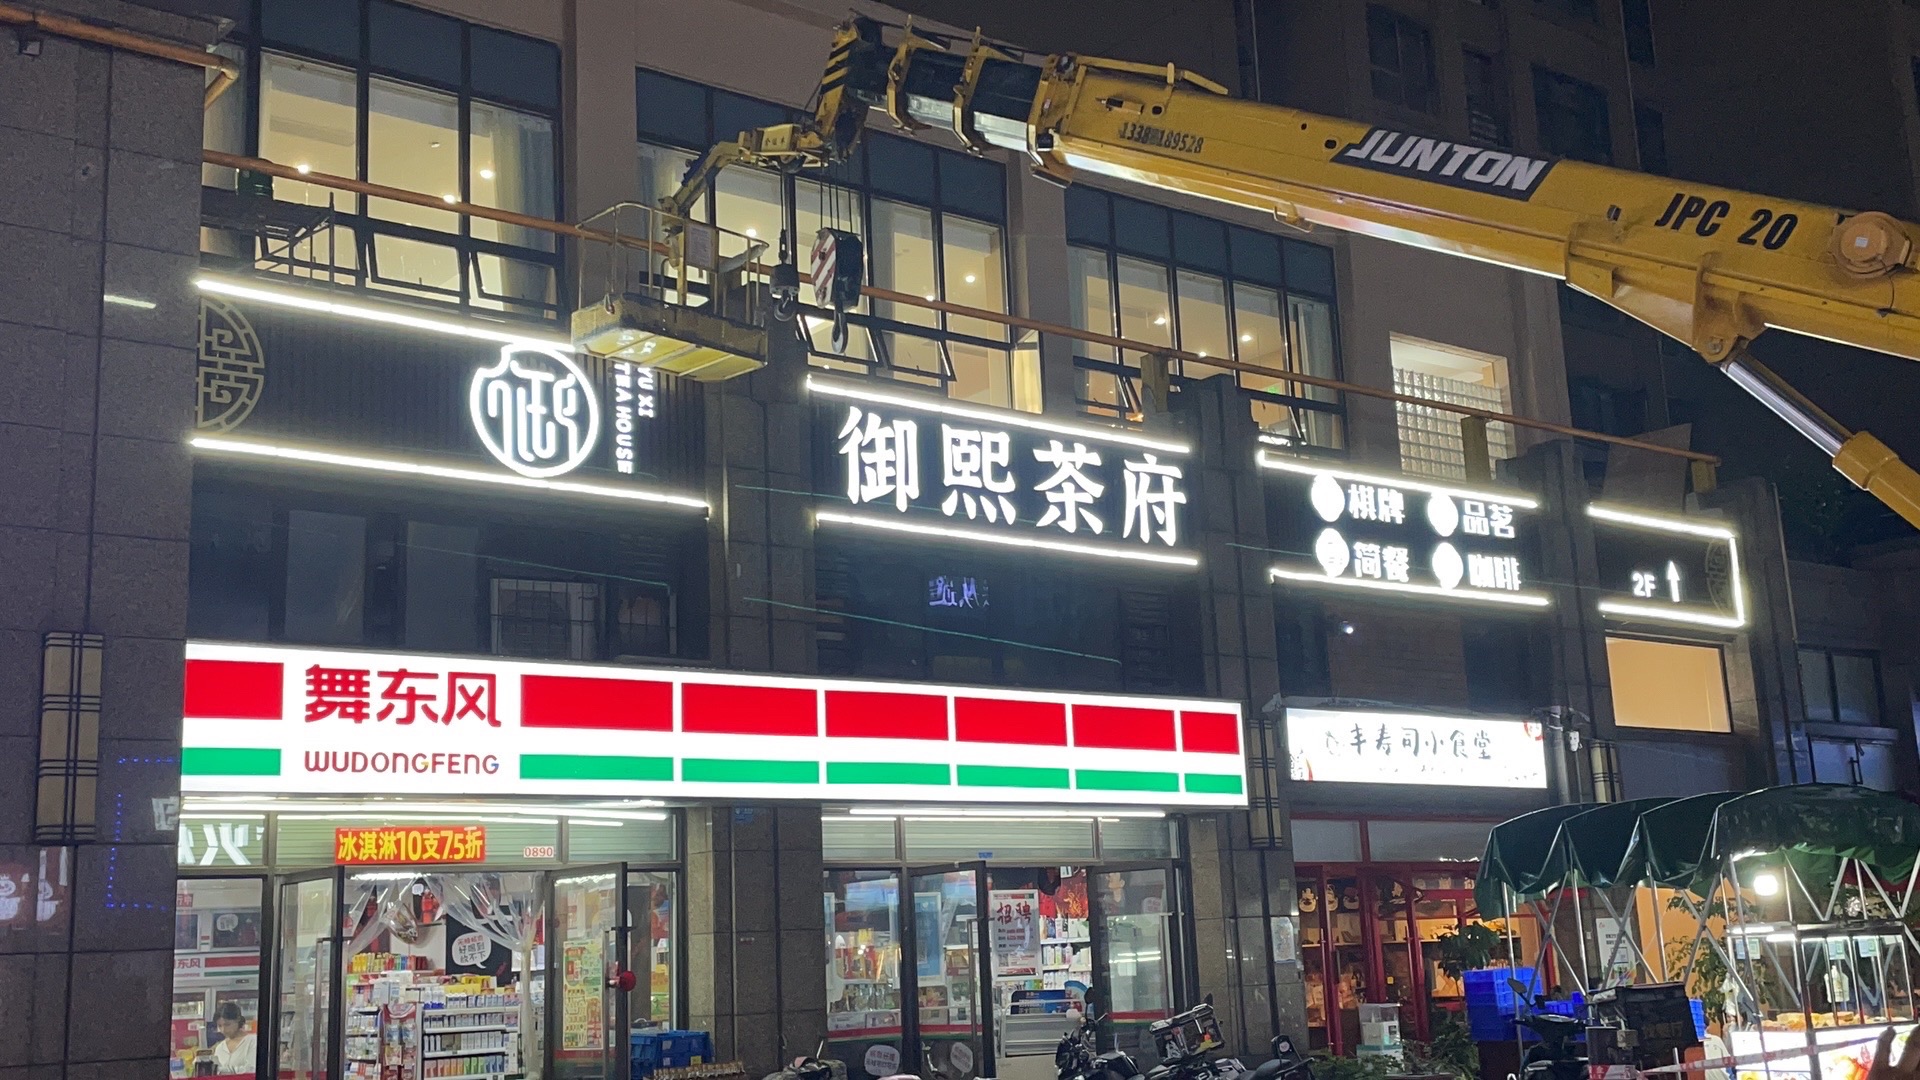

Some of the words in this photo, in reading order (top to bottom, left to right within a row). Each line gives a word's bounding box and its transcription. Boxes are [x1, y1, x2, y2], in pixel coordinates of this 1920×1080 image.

[1118, 122, 1204, 153] 1338189528
[1344, 129, 1548, 191] JUNTON
[1654, 193, 1730, 237] JPC
[1737, 208, 1798, 250] 20
[614, 362, 632, 403] TEA
[615, 405, 635, 475] HOUSE
[838, 405, 1187, 547] 御熙茶府
[1348, 483, 1406, 524] 棋牌
[1463, 500, 1516, 539] 品茗
[1353, 541, 1410, 583] 简餐
[1467, 553, 1523, 591] 咖啡
[1632, 571, 1656, 598] 2F
[304, 663, 502, 728] 舞东风
[304, 750, 500, 775] WUDONGFENG
[1325, 722, 1492, 760] 丰寿司小食堂
[524, 846, 554, 859] 0890
[996, 900, 1032, 926] 招聘
